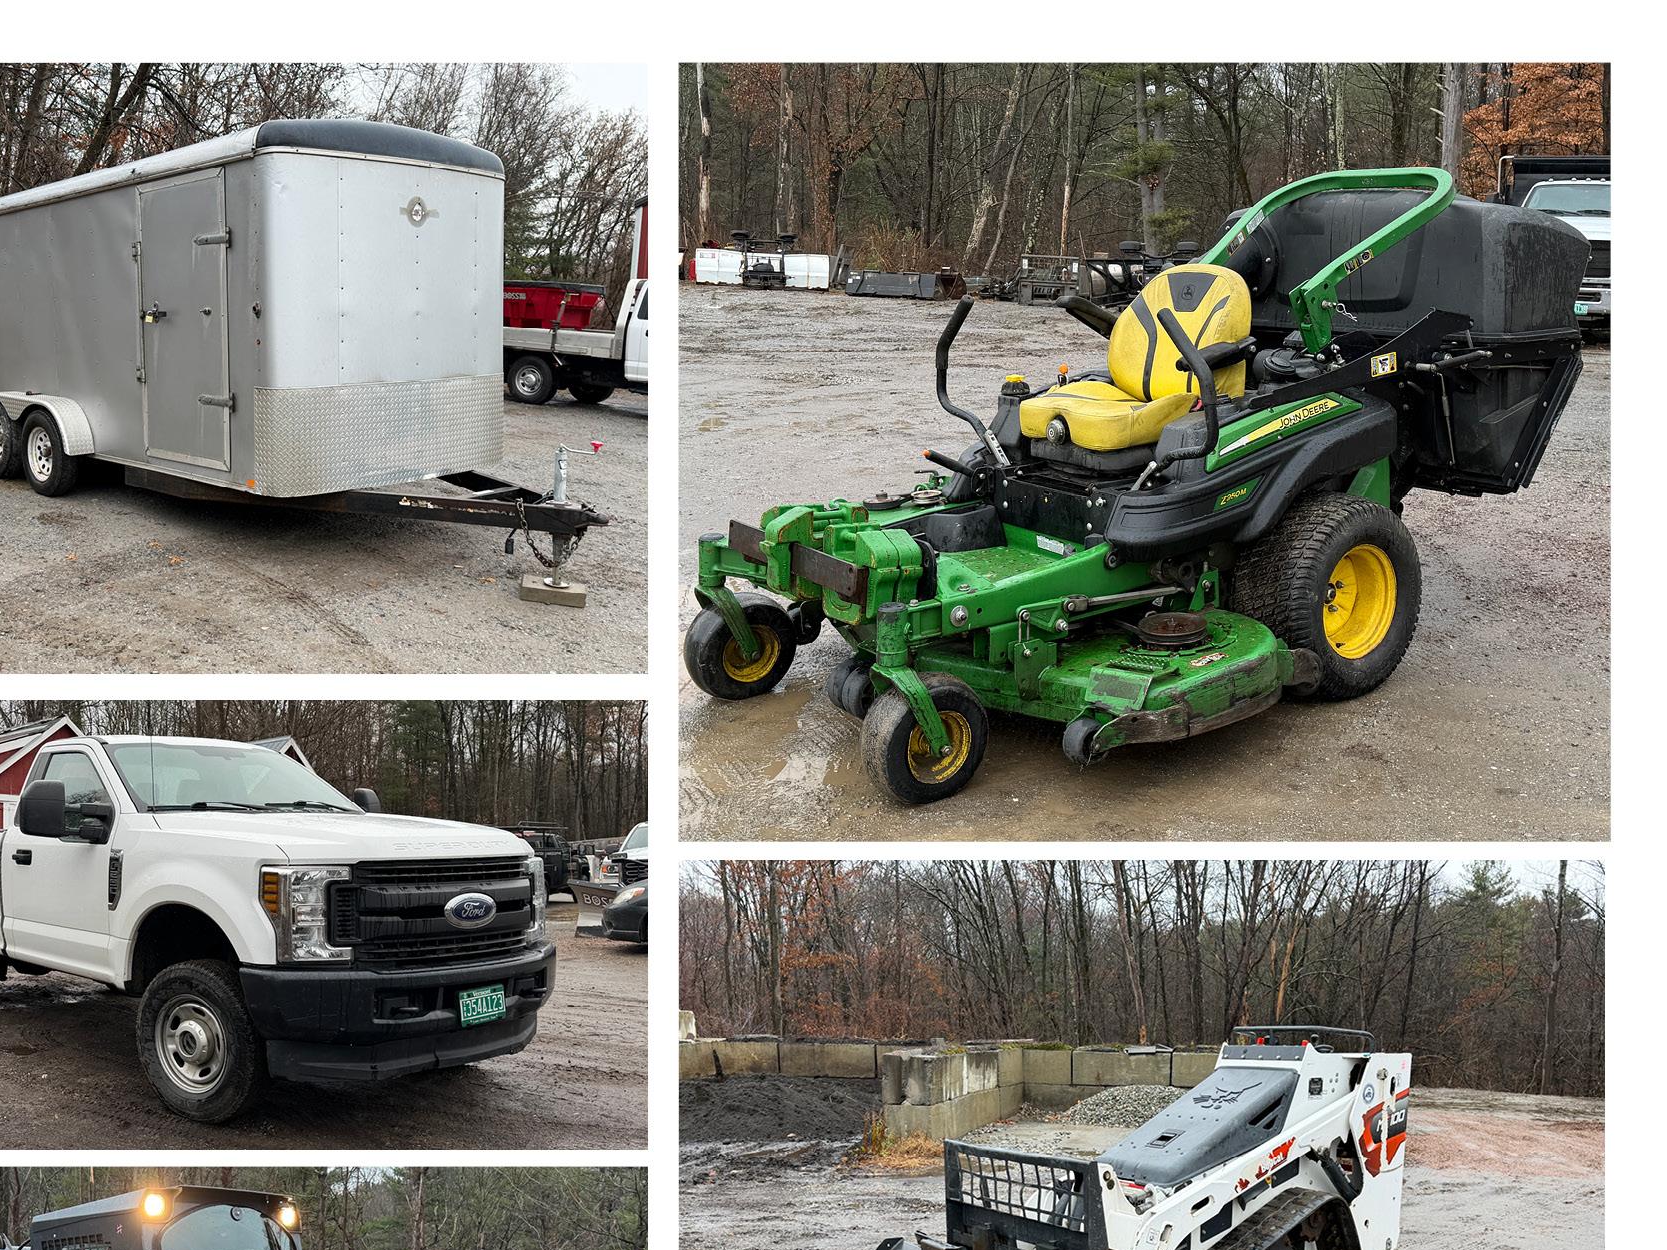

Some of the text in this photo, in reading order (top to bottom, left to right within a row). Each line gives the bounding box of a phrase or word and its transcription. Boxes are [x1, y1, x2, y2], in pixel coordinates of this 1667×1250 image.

[1279, 401, 1330, 429] JOHN DEERE
[461, 901, 486, 918] Ford
[583, 893, 613, 909] BOS
[466, 994, 504, 1016] 354A123
